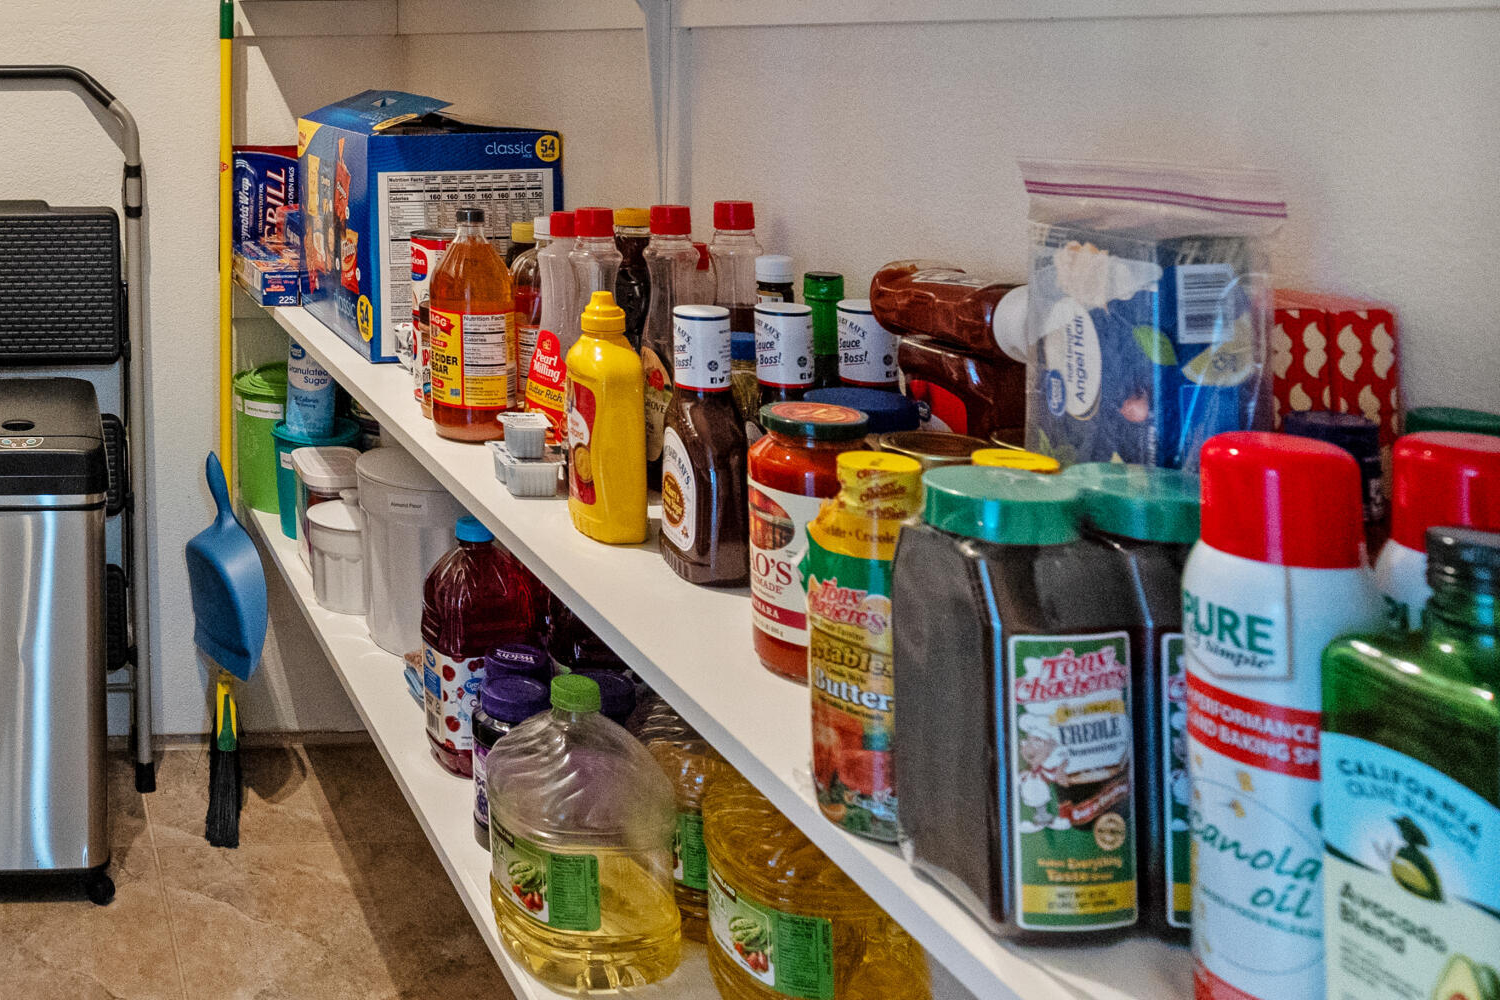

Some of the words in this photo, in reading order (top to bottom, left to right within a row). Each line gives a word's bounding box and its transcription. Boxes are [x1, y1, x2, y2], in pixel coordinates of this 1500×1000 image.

[485, 141, 532, 155] classic
[540, 139, 556, 153] 54
[359, 300, 370, 328] 54
[463, 315, 490, 323] Nutrition
[436, 352, 458, 366] CIDER
[536, 350, 558, 366] Pearl
[760, 352, 782, 366] Boss!
[844, 351, 867, 364] Boss!
[304, 376, 328, 386] Sugar
[533, 359, 561, 383] Milling
[1074, 350, 1089, 404] Angel
[528, 383, 545, 396] Butter
[546, 388, 563, 403] Rich
[815, 667, 893, 712] Butter
[1058, 717, 1120, 746] CREOLE
[1219, 723, 1290, 763] BAKING
[1251, 885, 1312, 918] oil
[1339, 882, 1448, 953] Avocado
[1339, 905, 1407, 954] Blend
